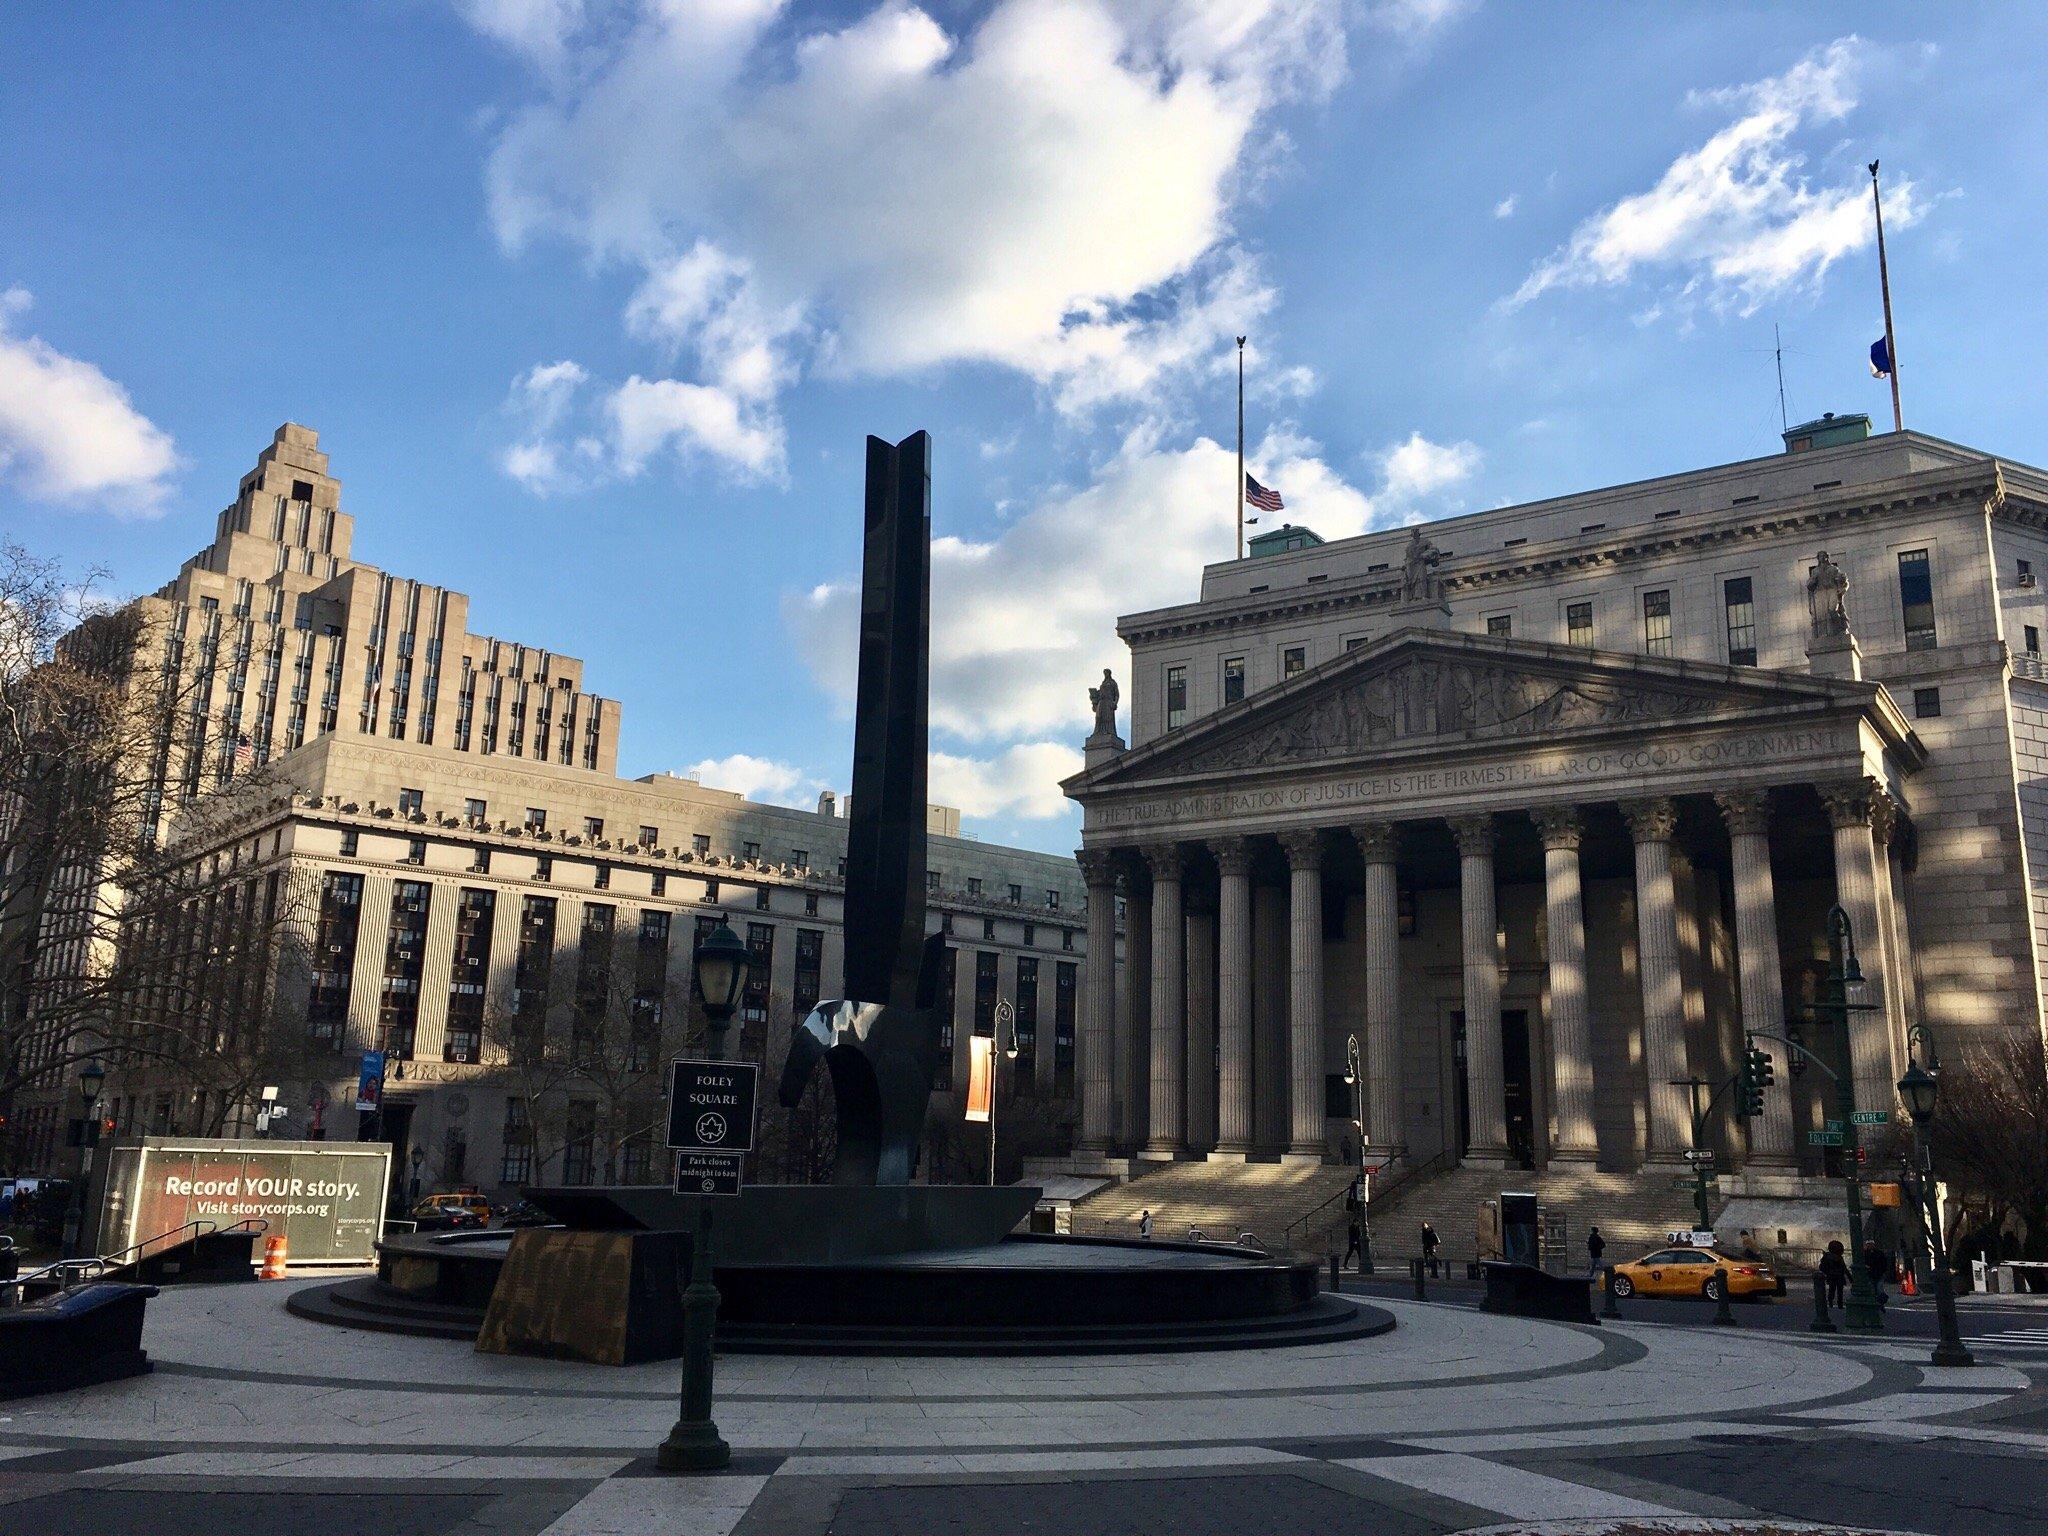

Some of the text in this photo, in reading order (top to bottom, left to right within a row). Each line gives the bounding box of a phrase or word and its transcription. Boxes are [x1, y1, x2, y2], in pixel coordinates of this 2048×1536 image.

[1097, 733, 1839, 823] THE TRUE ADMINISTRATION OF JUSTICE IS THE FIRMEST PILLAR OF GOOD GOVERNMENT
[696, 1075, 734, 1087] FOLEY
[689, 1093, 738, 1105] SQUARE
[1853, 1113, 1878, 1123] CENTRE
[690, 1156, 731, 1166] Park closes
[681, 1168, 714, 1179] midnight
[722, 1170, 737, 1178] 6am
[165, 1176, 360, 1202] Record YOUR story.
[197, 1201, 330, 1218] Visit storycorps.org
